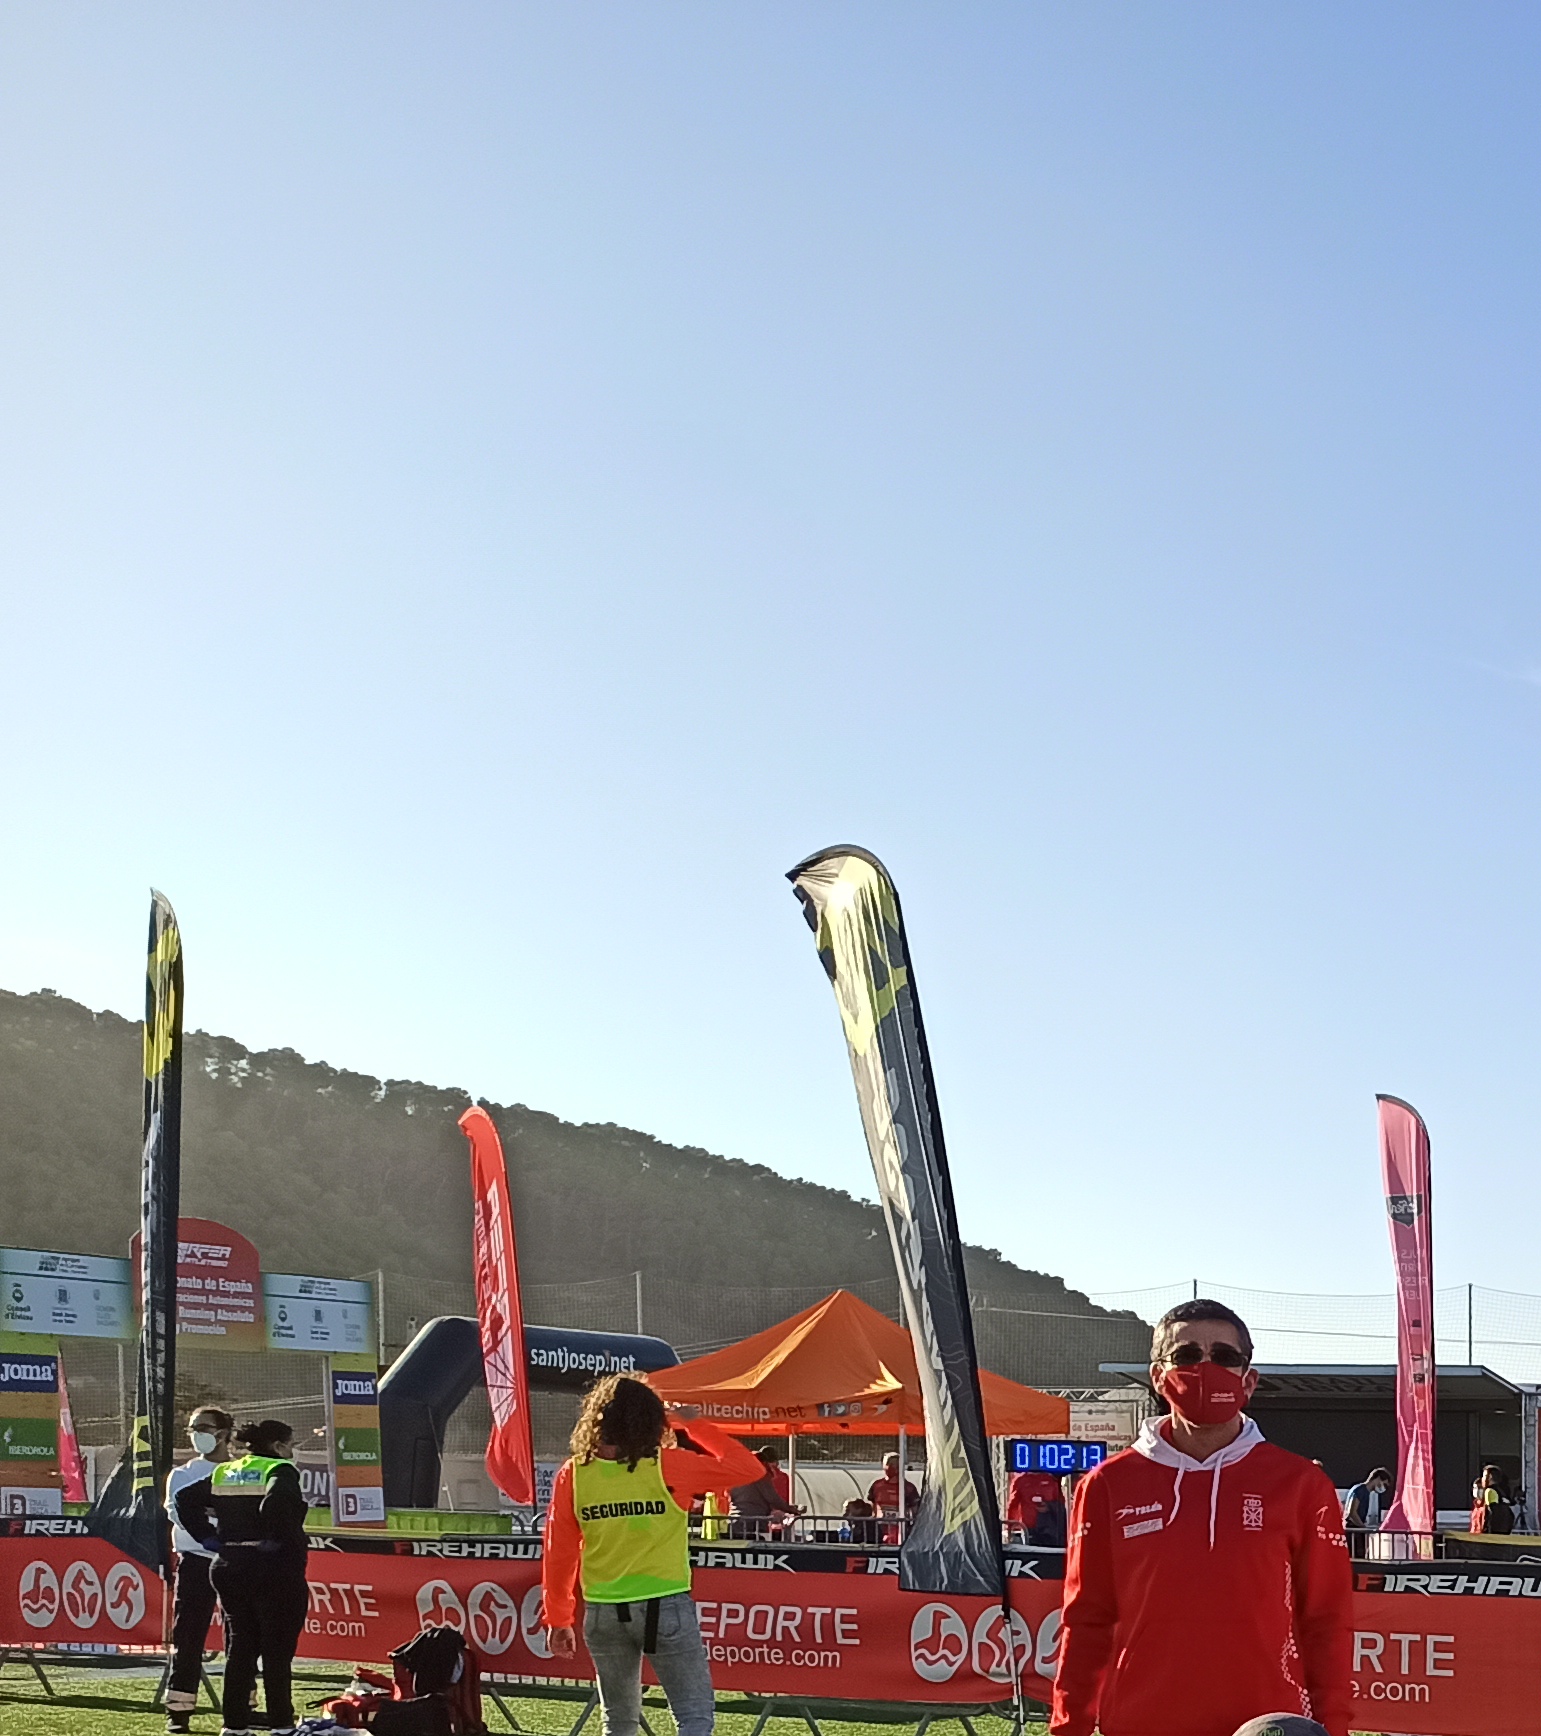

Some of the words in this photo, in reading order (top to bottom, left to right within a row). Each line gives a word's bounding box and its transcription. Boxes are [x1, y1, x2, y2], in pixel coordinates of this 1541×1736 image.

[581, 1499, 667, 1522] SEGURIDAD
[8, 1519, 89, 1537] FIREH
[395, 1541, 544, 1560] FIREHAW
[308, 1581, 380, 1617] RTE
[1352, 1631, 1455, 1677] RTE
